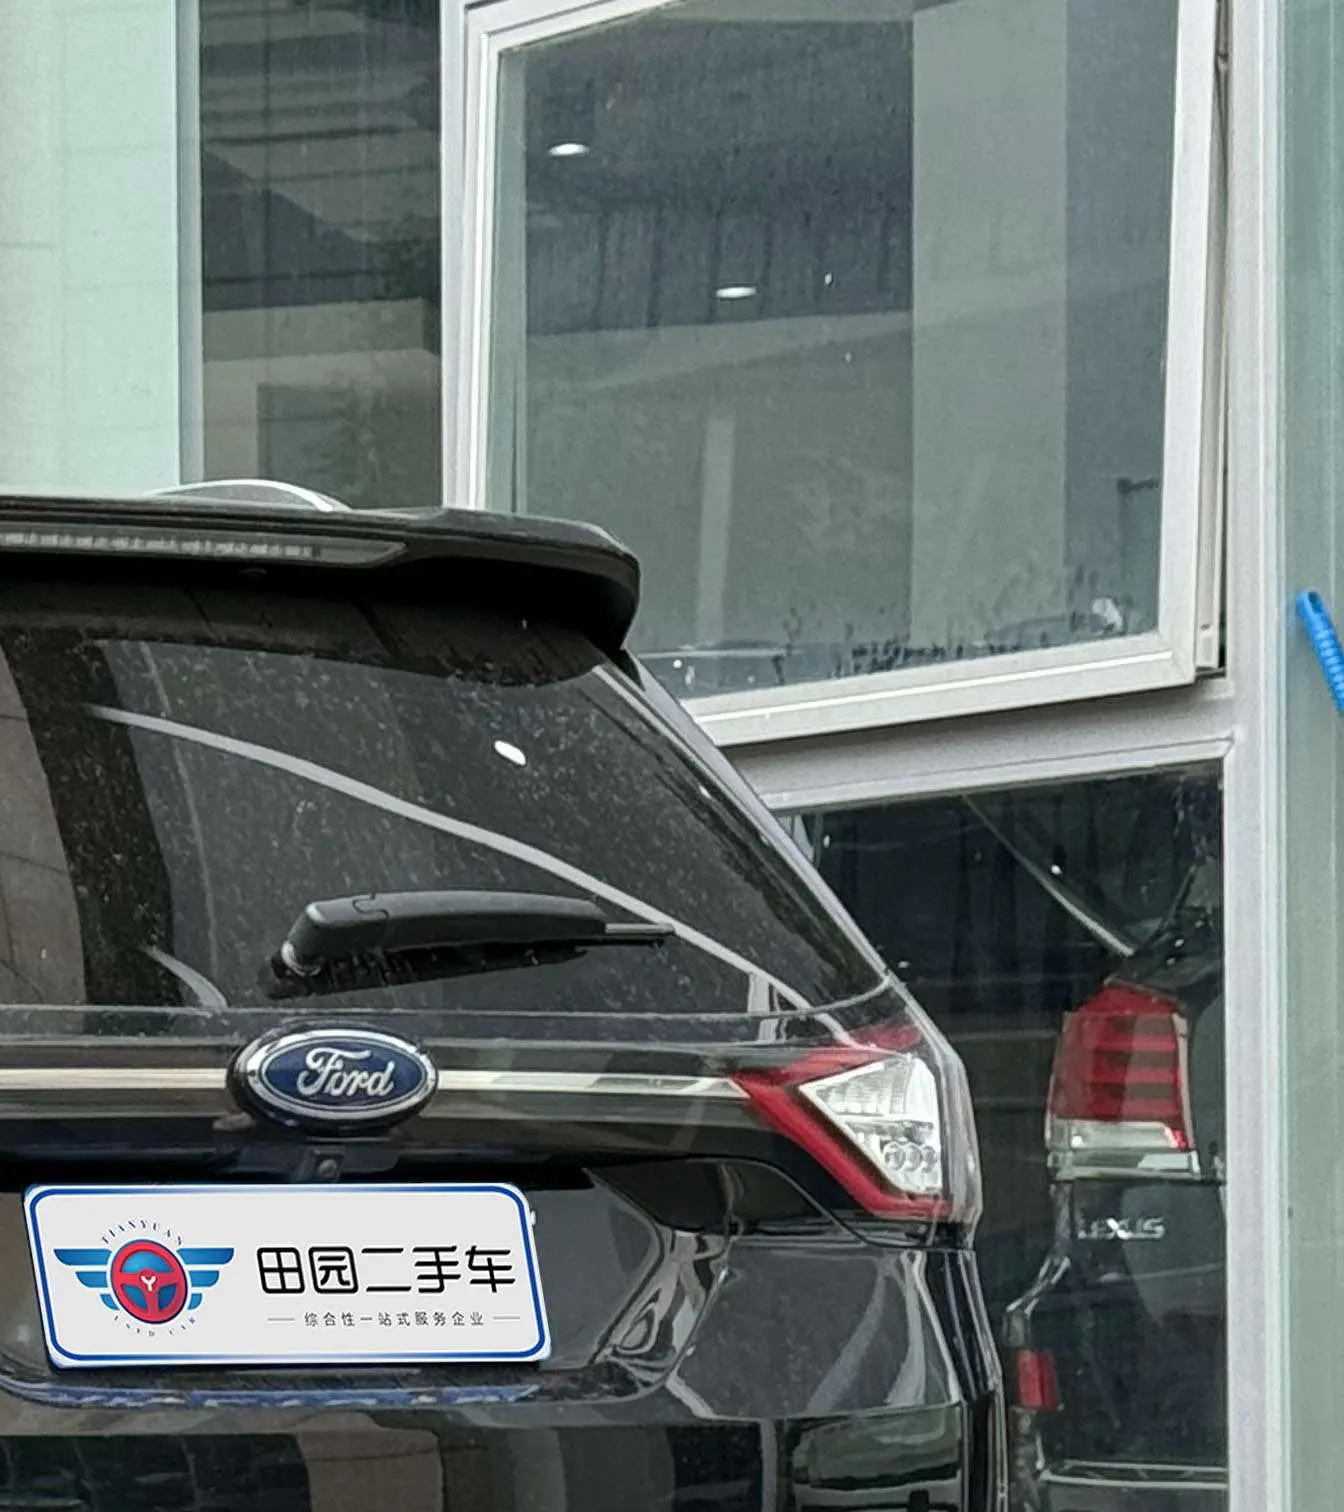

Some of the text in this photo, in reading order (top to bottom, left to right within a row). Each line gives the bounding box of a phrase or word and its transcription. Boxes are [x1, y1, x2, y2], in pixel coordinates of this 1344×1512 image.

[297, 1047, 395, 1097] Ford
[256, 1245, 516, 1294] 田园二手车
[304, 1311, 484, 1327] 综合性一站式服务企业
